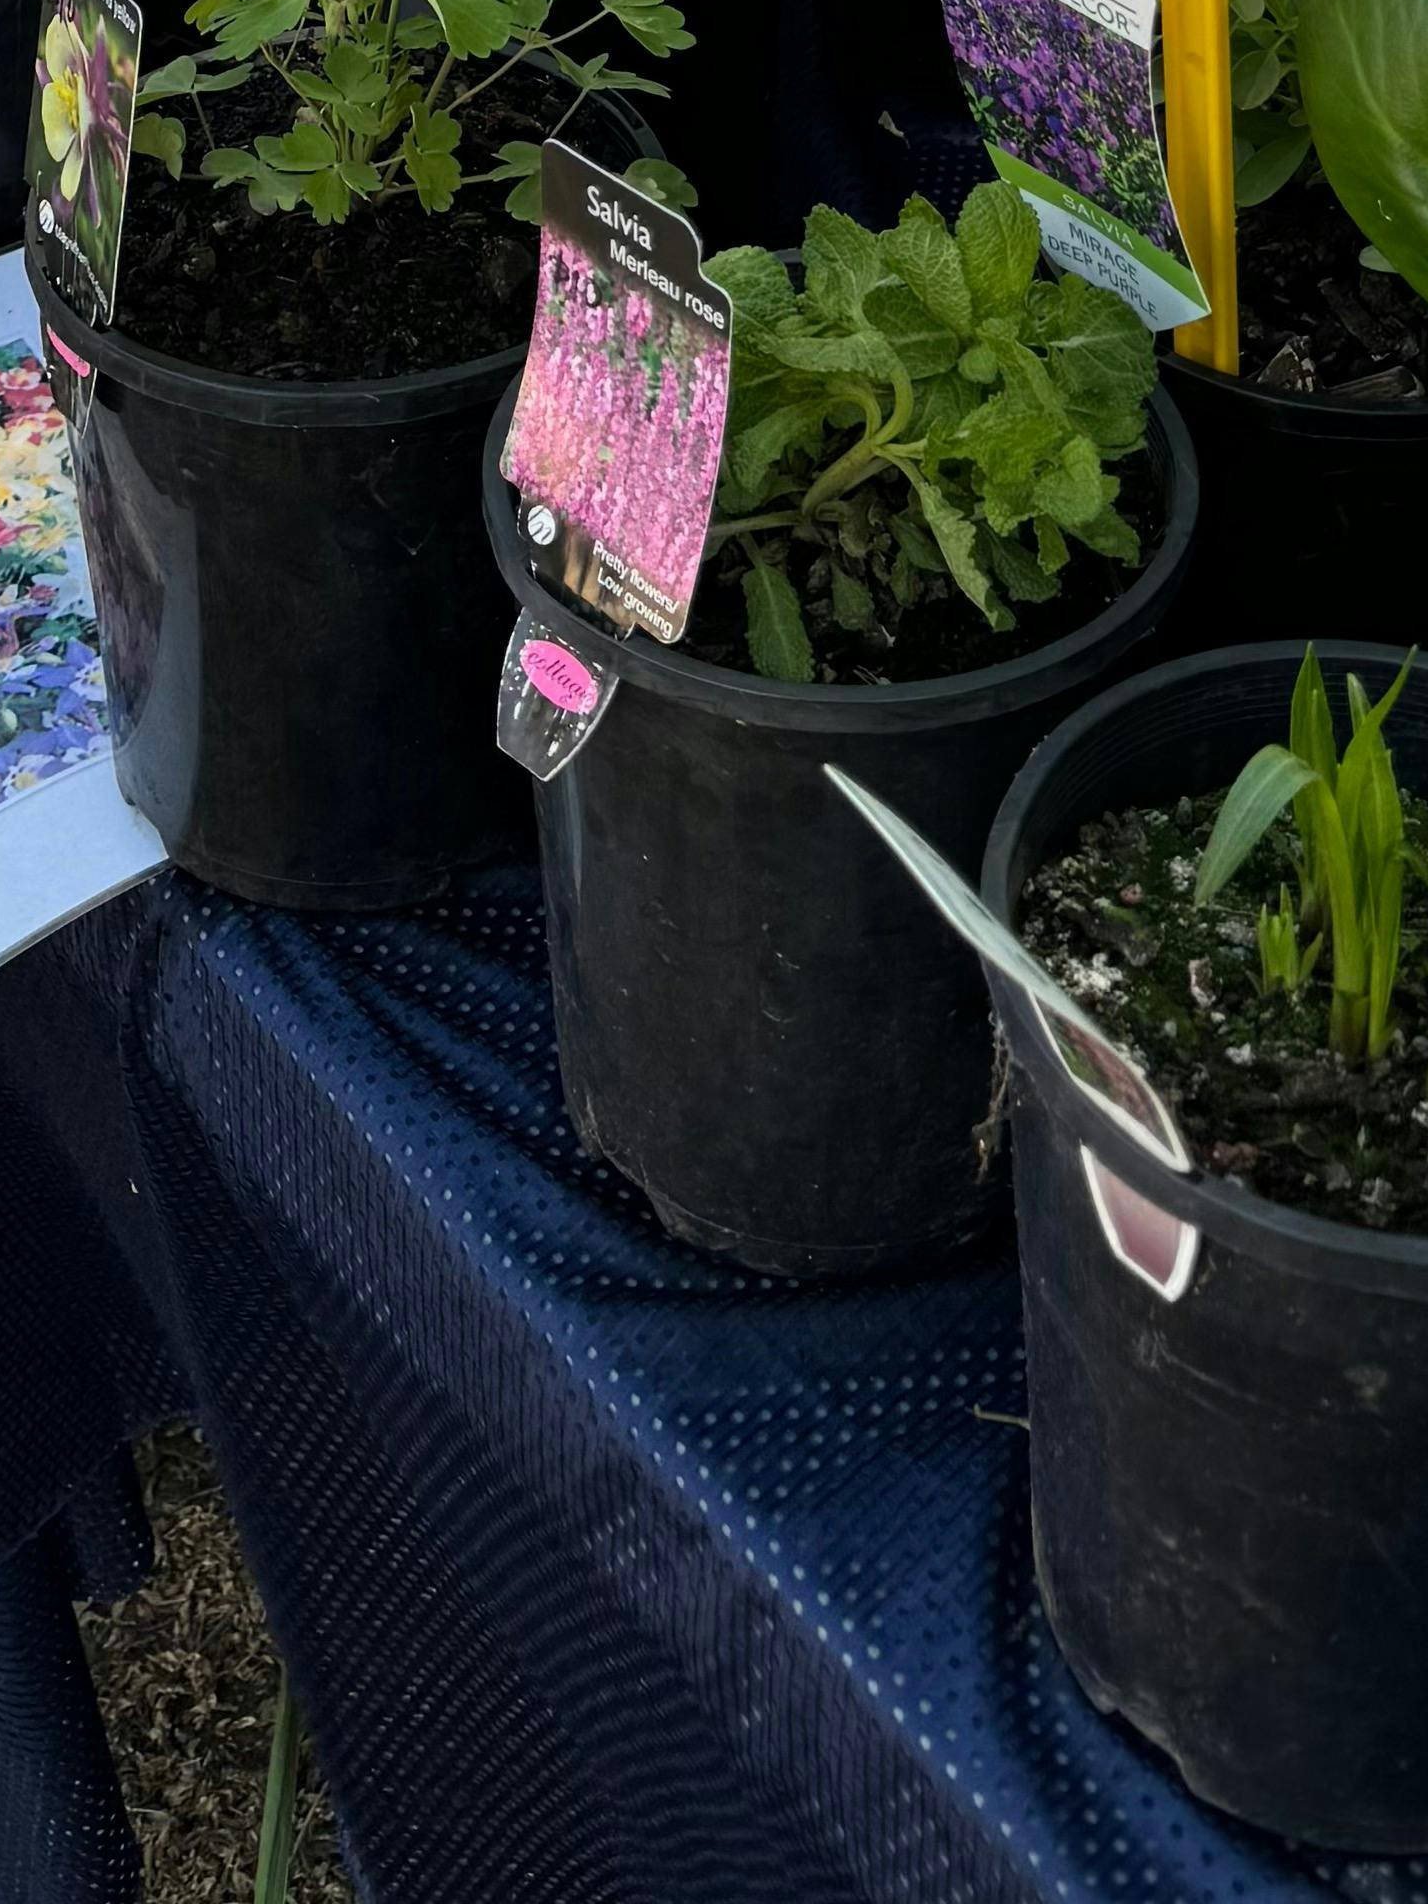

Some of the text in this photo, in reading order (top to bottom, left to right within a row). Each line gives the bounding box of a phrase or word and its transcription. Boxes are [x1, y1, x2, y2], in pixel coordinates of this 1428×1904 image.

[585, 185, 654, 252] Salvia
[1061, 191, 1136, 252] SALVIA
[608, 237, 727, 332] Merleau rose
[1047, 233, 1160, 322] DEEP PURPLE
[1067, 220, 1142, 287] MIRAGE
[591, 540, 632, 584] Pretty
[596, 566, 674, 639] Low growing
